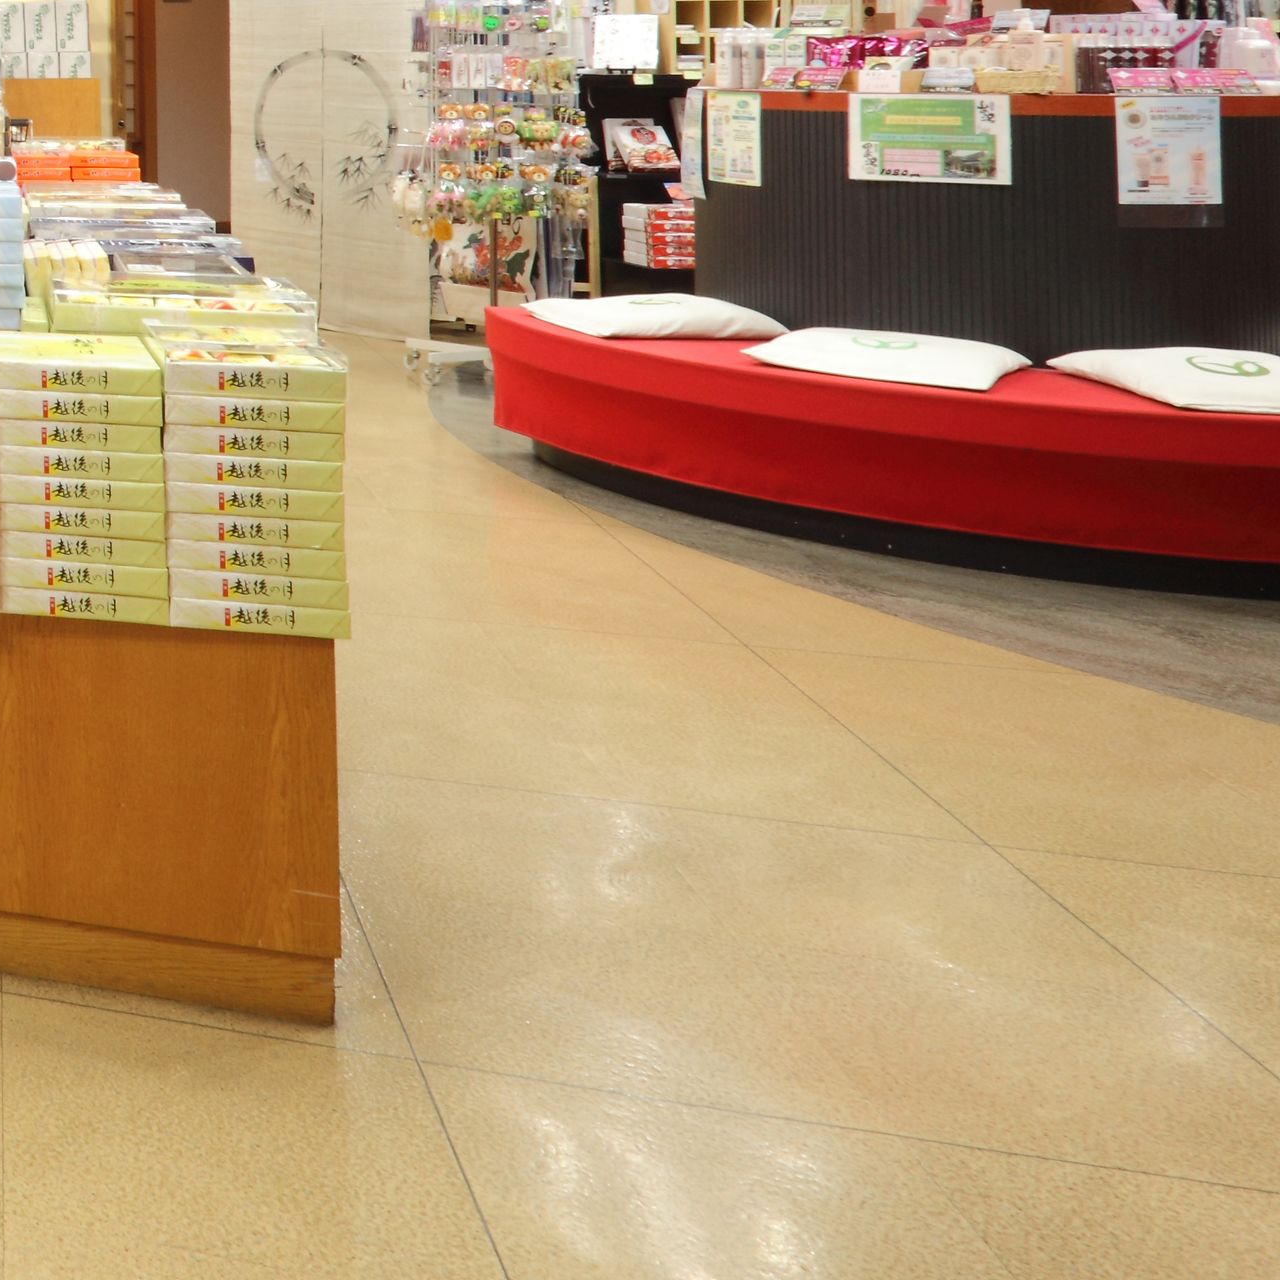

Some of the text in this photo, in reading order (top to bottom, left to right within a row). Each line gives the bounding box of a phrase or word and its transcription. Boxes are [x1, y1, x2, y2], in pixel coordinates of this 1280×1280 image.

[48, 370, 108, 387] 越後の月
[225, 371, 289, 392] 越後の月
[49, 400, 110, 418] 越後の月
[227, 406, 291, 426] 越後の月
[48, 427, 108, 444] 越後の月
[226, 435, 290, 452] 越後の月
[50, 456, 111, 473] 越後の月
[224, 463, 288, 480] 越後の月
[51, 483, 112, 503] 越後の月
[225, 492, 290, 512] 越後の月
[51, 511, 112, 529] 越後の月
[225, 522, 290, 541] 越後の月
[53, 539, 113, 558] 越後の月
[227, 551, 291, 569] 越後の月
[54, 568, 115, 586] 越後の月
[230, 580, 294, 598] 越後の月
[56, 597, 117, 617] 越後の月
[231, 608, 296, 627] 越後の月
